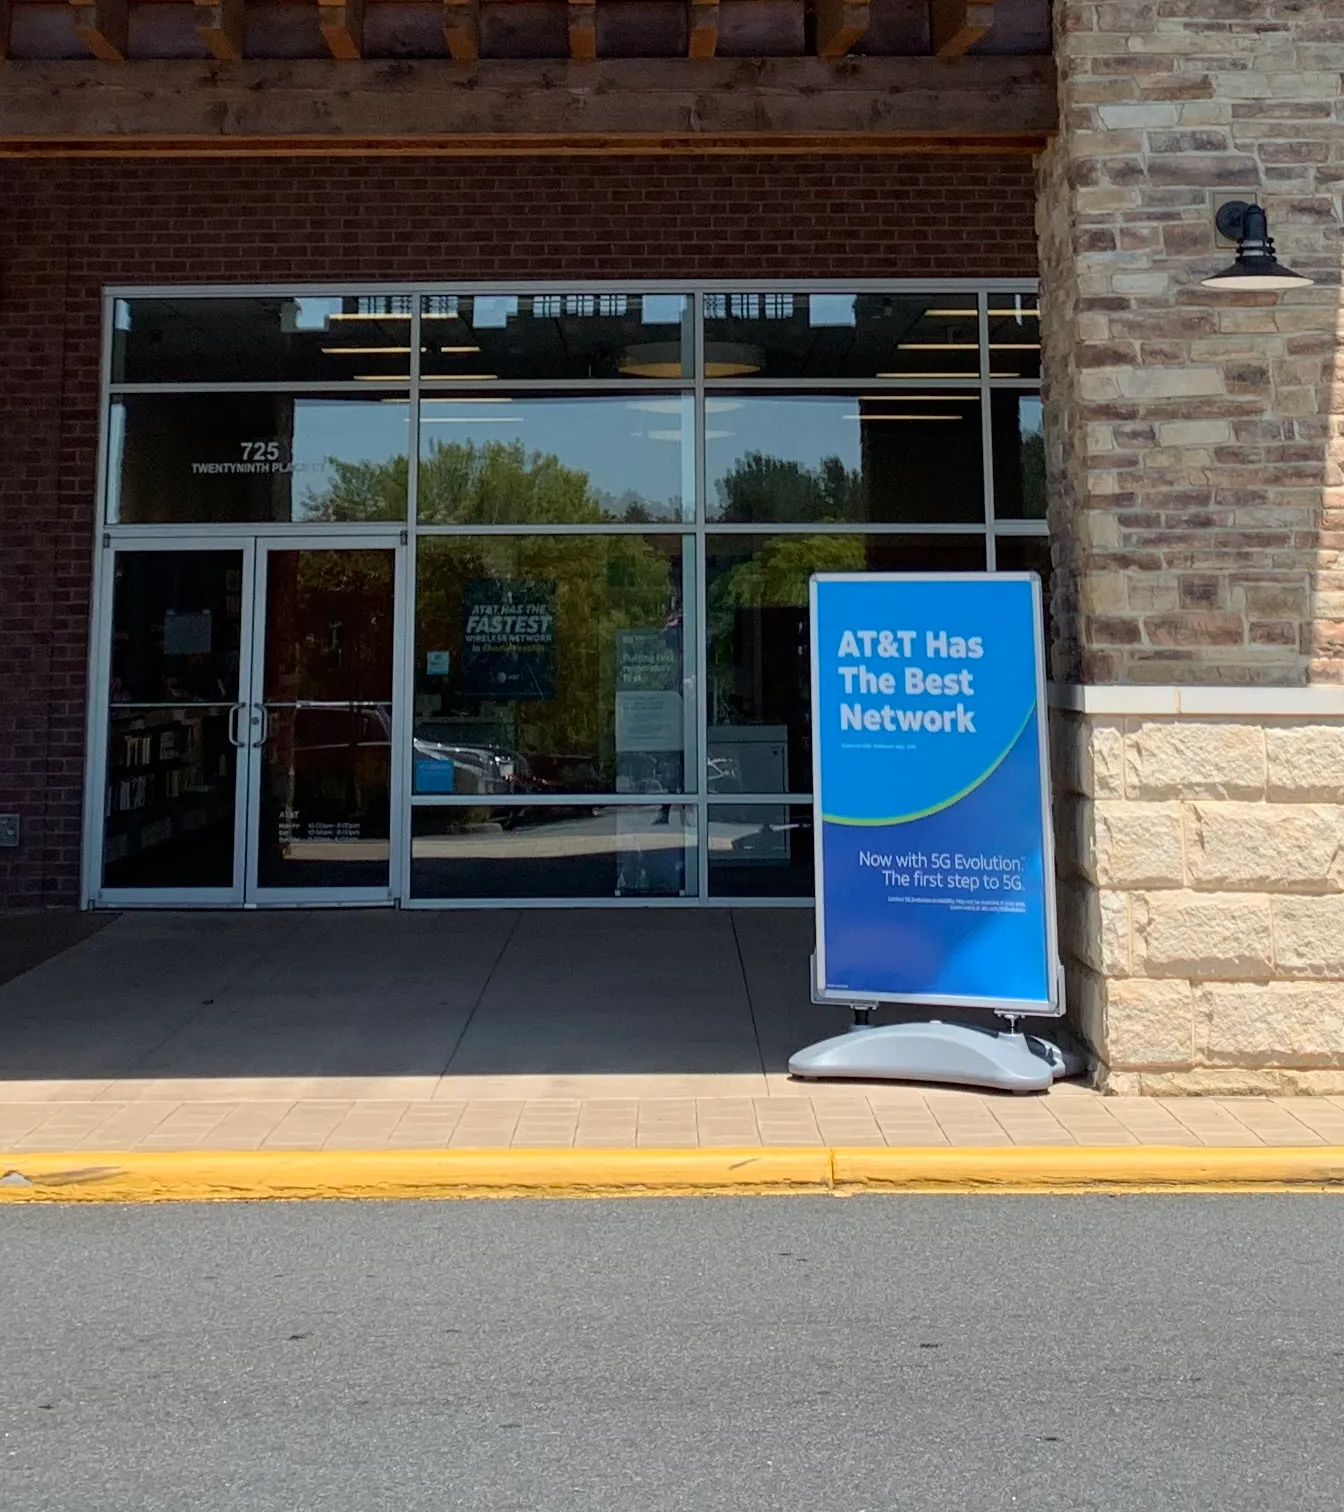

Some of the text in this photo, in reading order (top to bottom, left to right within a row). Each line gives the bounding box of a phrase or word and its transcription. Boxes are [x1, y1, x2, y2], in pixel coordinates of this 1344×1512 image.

[240, 441, 280, 461] 725
[191, 462, 269, 474] TWENTYNINTH
[501, 604, 523, 615] HAS
[526, 603, 548, 615] THE
[465, 615, 554, 634] FASTEST
[508, 634, 553, 643] NETWORK
[837, 630, 985, 659] AT&T Has
[838, 664, 975, 696] The Best
[840, 702, 977, 733] Network
[859, 850, 893, 867] Now
[896, 851, 928, 868] with
[931, 853, 950, 869] 5G
[881, 870, 910, 886] The
[913, 871, 943, 888] first
[947, 874, 980, 892] step
[983, 874, 1000, 890] to
